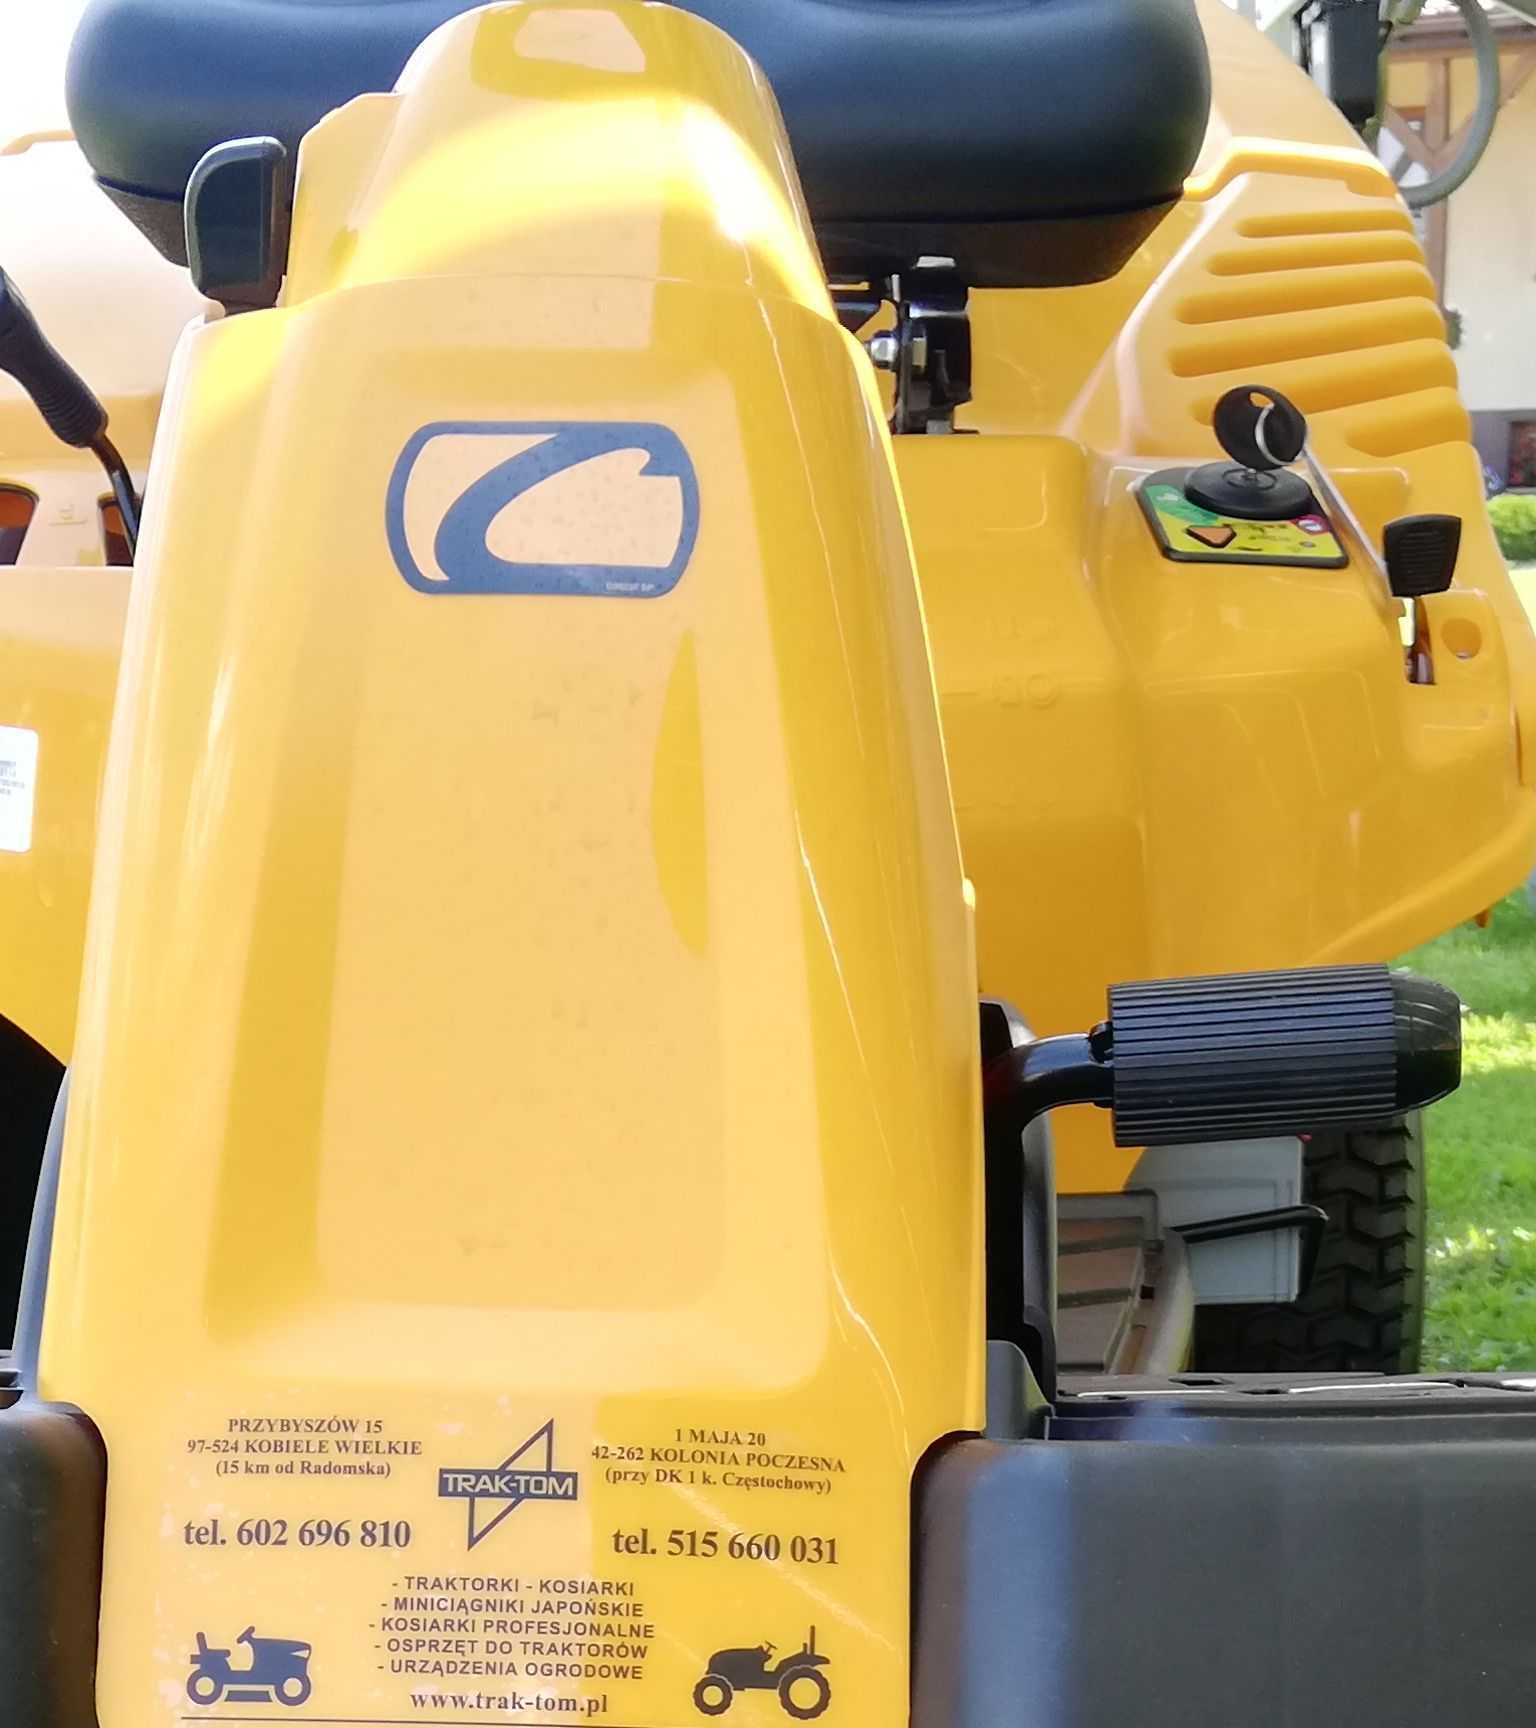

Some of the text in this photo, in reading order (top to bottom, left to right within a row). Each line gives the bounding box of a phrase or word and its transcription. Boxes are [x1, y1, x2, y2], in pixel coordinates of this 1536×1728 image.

[228, 1415, 383, 1434] PRZYBYSZÓW 15
[187, 1439, 422, 1456] 97-524 KOBIELE WIELKIE
[675, 1428, 766, 1447] 1 MAJA 20
[215, 1459, 391, 1479] (15 km od Radomska)
[591, 1445, 846, 1473] 42-262 KOLONIA POCZESNA
[445, 1474, 573, 1497] TRAK-TOM
[605, 1467, 832, 1496] (przy DK 1 k. Częstochowy)
[183, 1518, 411, 1548] tel. 602 696 810
[612, 1527, 839, 1565] tel. 515 660 031
[404, 1575, 519, 1593] TRAKTORKI
[539, 1579, 634, 1597] KOSIARKI
[393, 1596, 524, 1616] MINICIĄGNIKI
[531, 1598, 644, 1618] JAPOŃSKIE
[381, 1616, 476, 1633] KOSIARKI
[483, 1619, 655, 1639] PROFESJONALNE
[387, 1638, 479, 1657] OSPRZĘT
[485, 1639, 513, 1655] DO
[519, 1640, 649, 1659] TRAKTORÓW
[390, 1658, 518, 1678] URZĄDZENIA
[525, 1662, 644, 1680] OGRODOWE
[409, 1691, 608, 1718] www.trak-tom.pl
